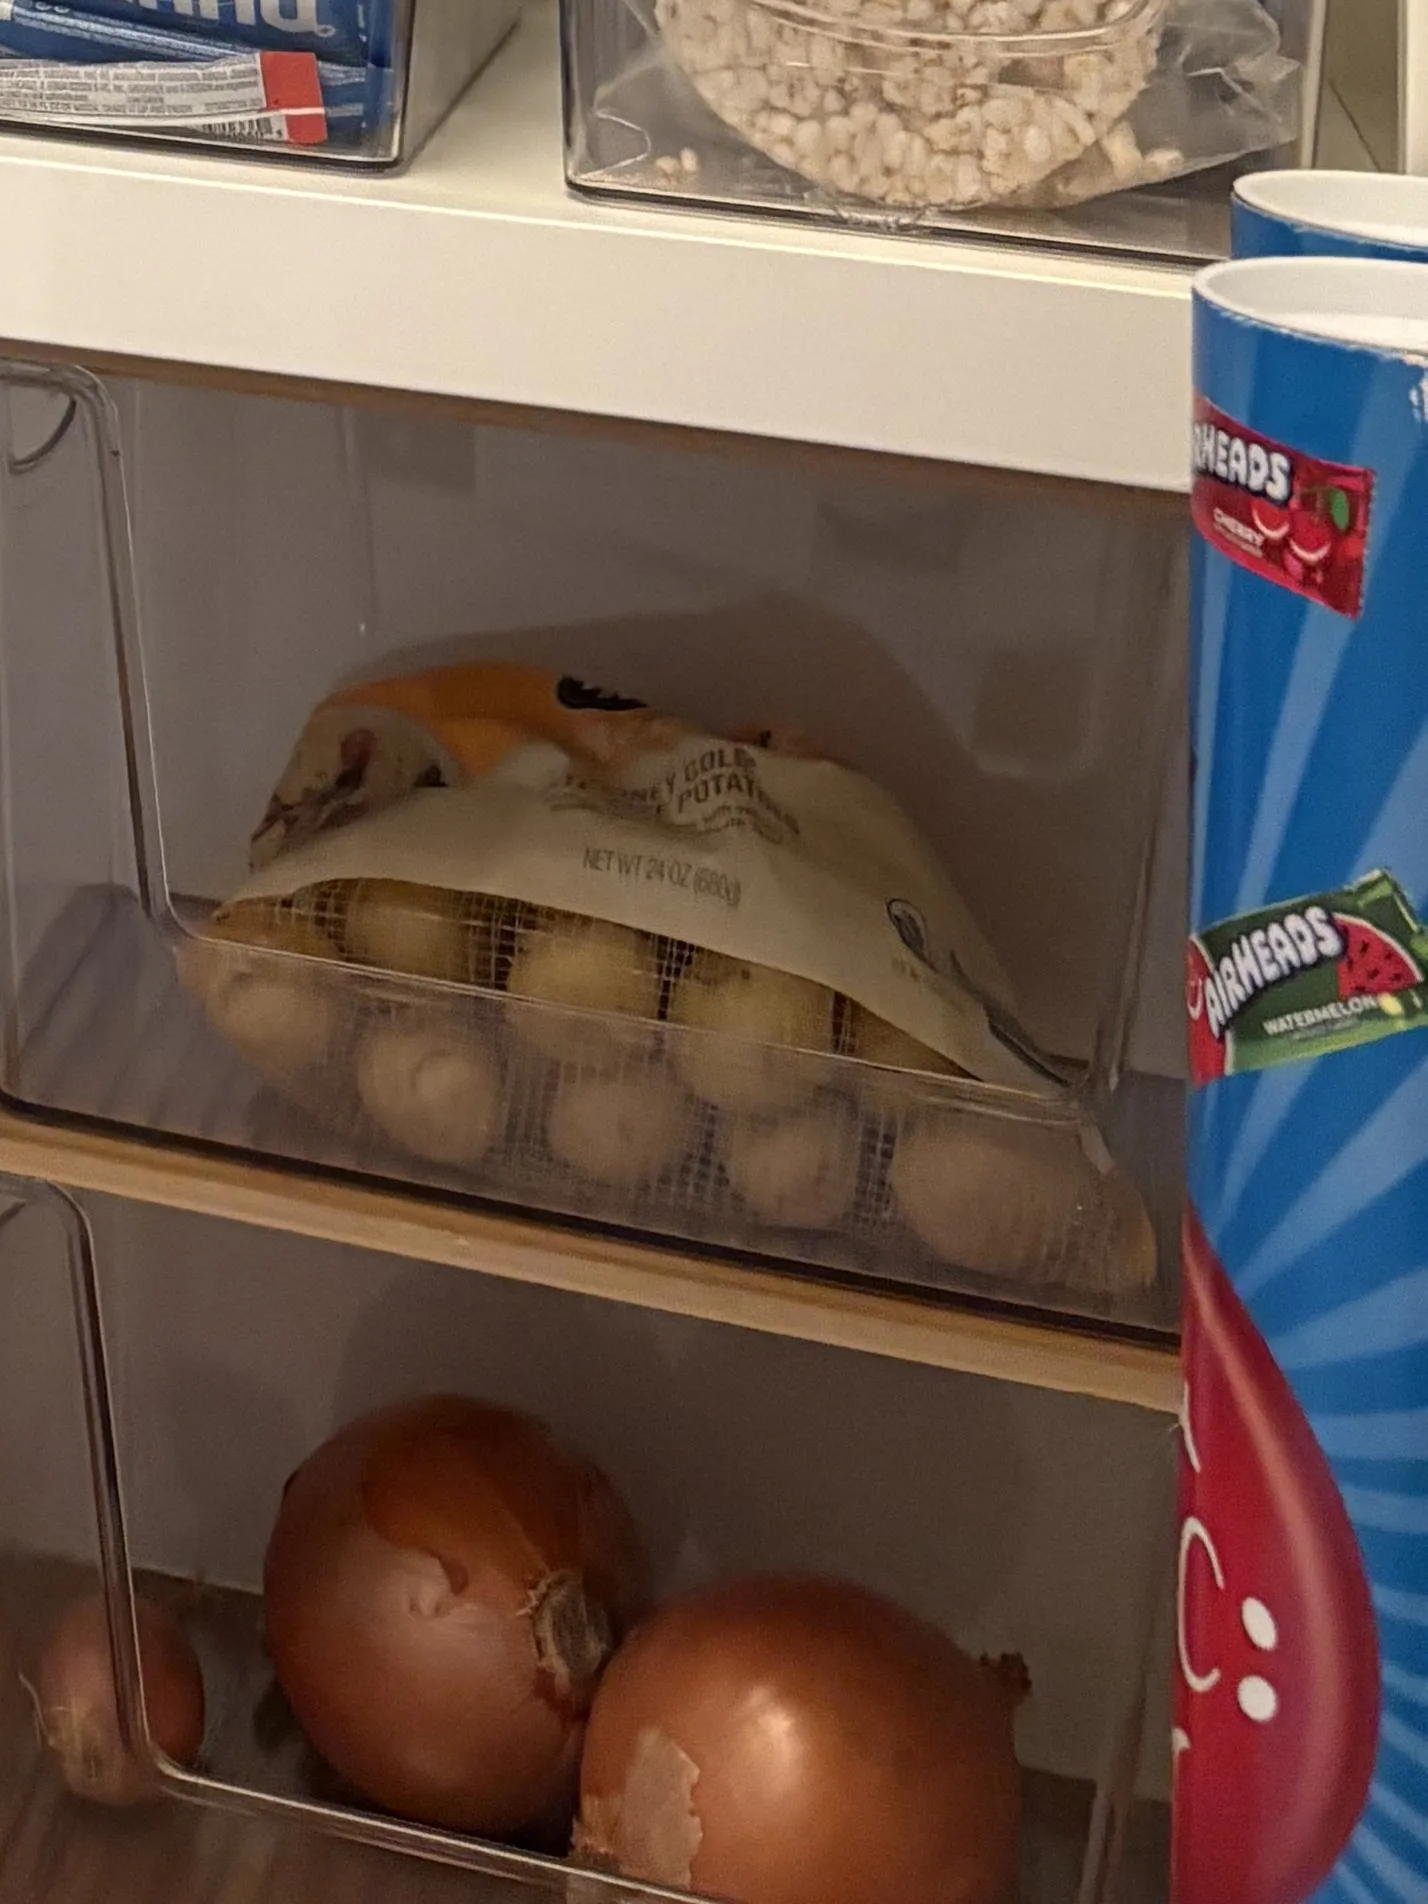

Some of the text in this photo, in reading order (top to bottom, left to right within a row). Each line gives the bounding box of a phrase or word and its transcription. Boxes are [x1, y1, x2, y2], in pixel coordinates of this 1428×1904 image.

[582, 847, 615, 872] NET
[1204, 906, 1341, 1039] AIRHEADS
[1262, 994, 1378, 1035] WATERMELON
